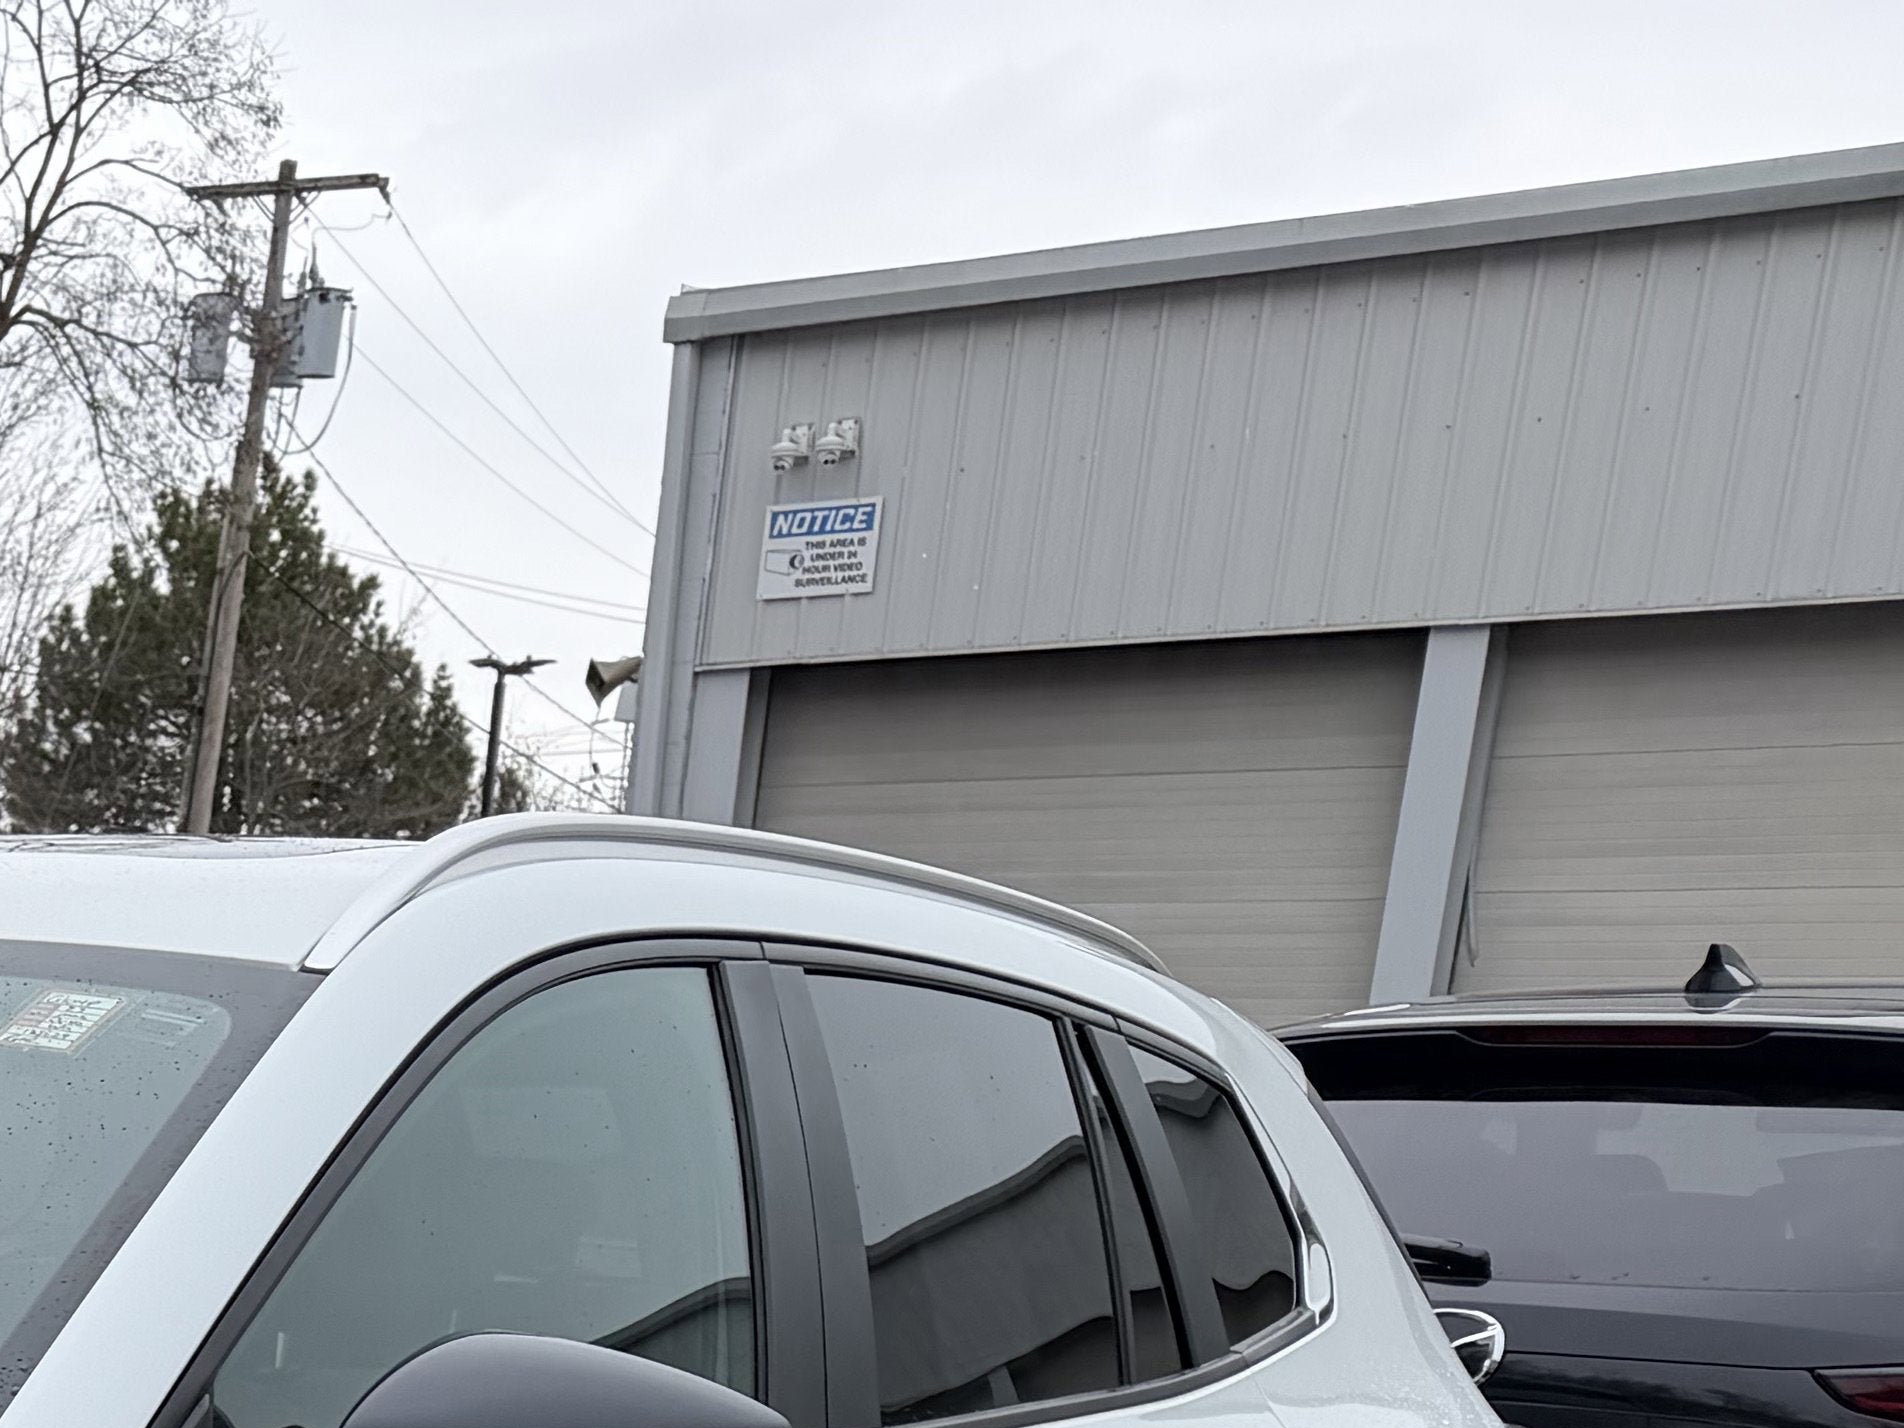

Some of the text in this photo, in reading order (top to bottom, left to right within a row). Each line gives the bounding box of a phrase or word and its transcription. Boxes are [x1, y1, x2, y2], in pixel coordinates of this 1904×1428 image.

[772, 506, 873, 537] NOTICE
[805, 536, 867, 550] THIS AREA IS
[810, 550, 858, 562] UNDER 24
[802, 561, 863, 575] HOUR VIDEO
[794, 573, 868, 588] SURVEILLANCE
